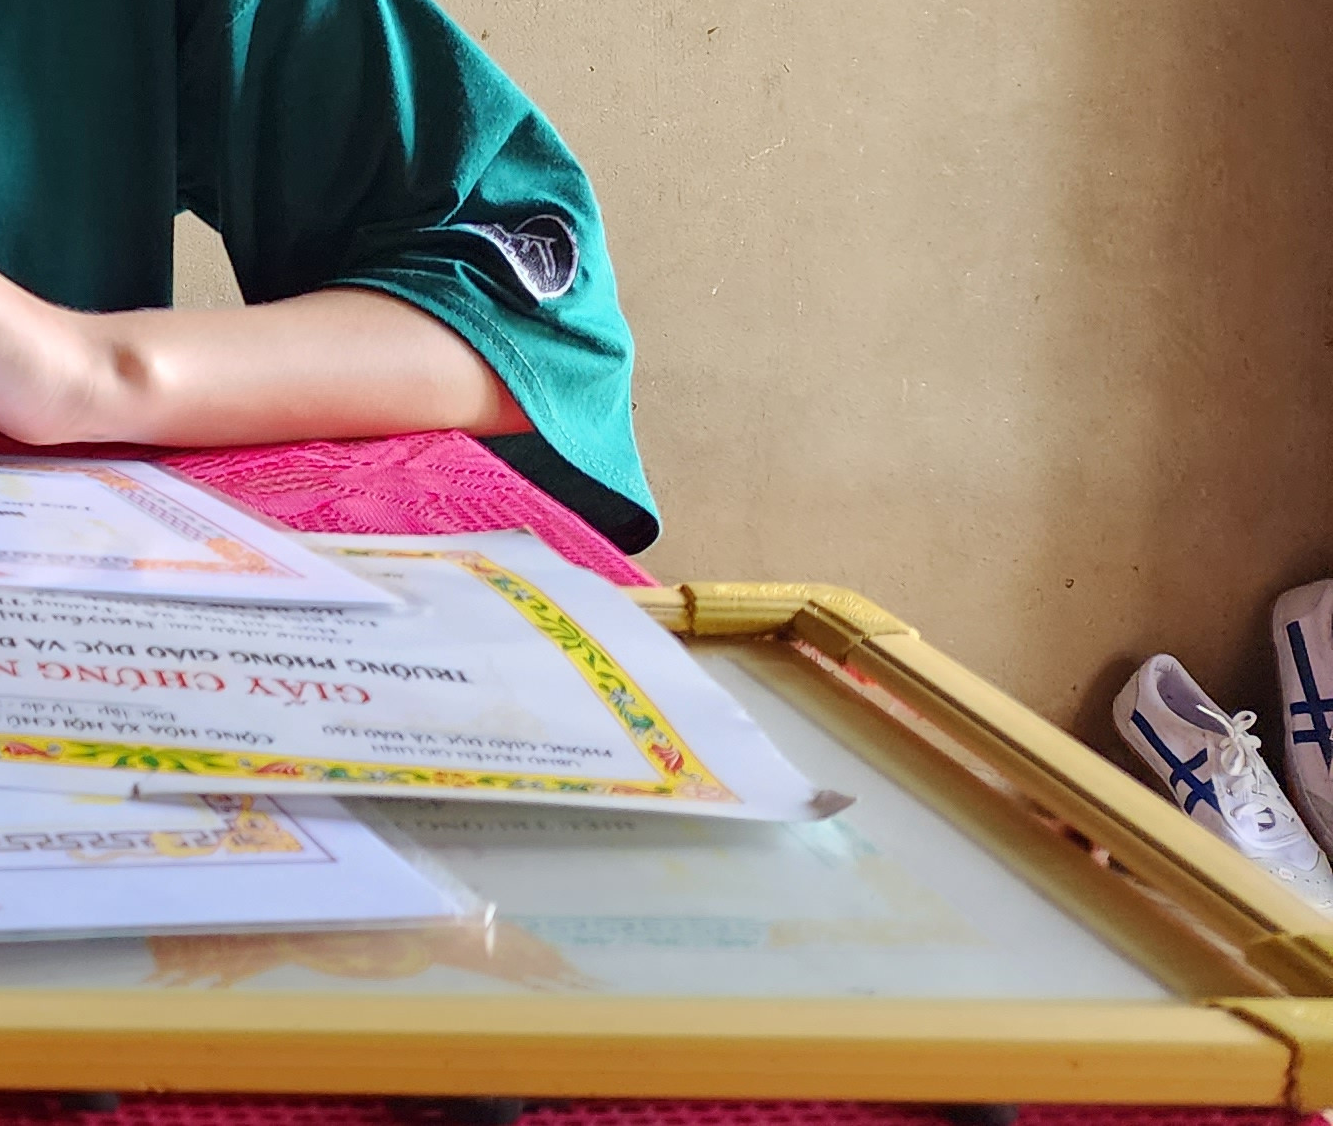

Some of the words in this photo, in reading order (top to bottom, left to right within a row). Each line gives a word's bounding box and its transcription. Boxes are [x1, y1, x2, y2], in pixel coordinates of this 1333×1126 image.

[23, 636, 65, 653] VÀ
[73, 638, 134, 657] DỤC
[144, 644, 219, 663] GIÁO
[226, 649, 335, 670] PHÒNG
[35, 660, 225, 692] CHỨNG
[245, 675, 370, 706] GIẤY
[204, 728, 274, 745] CỘNG
